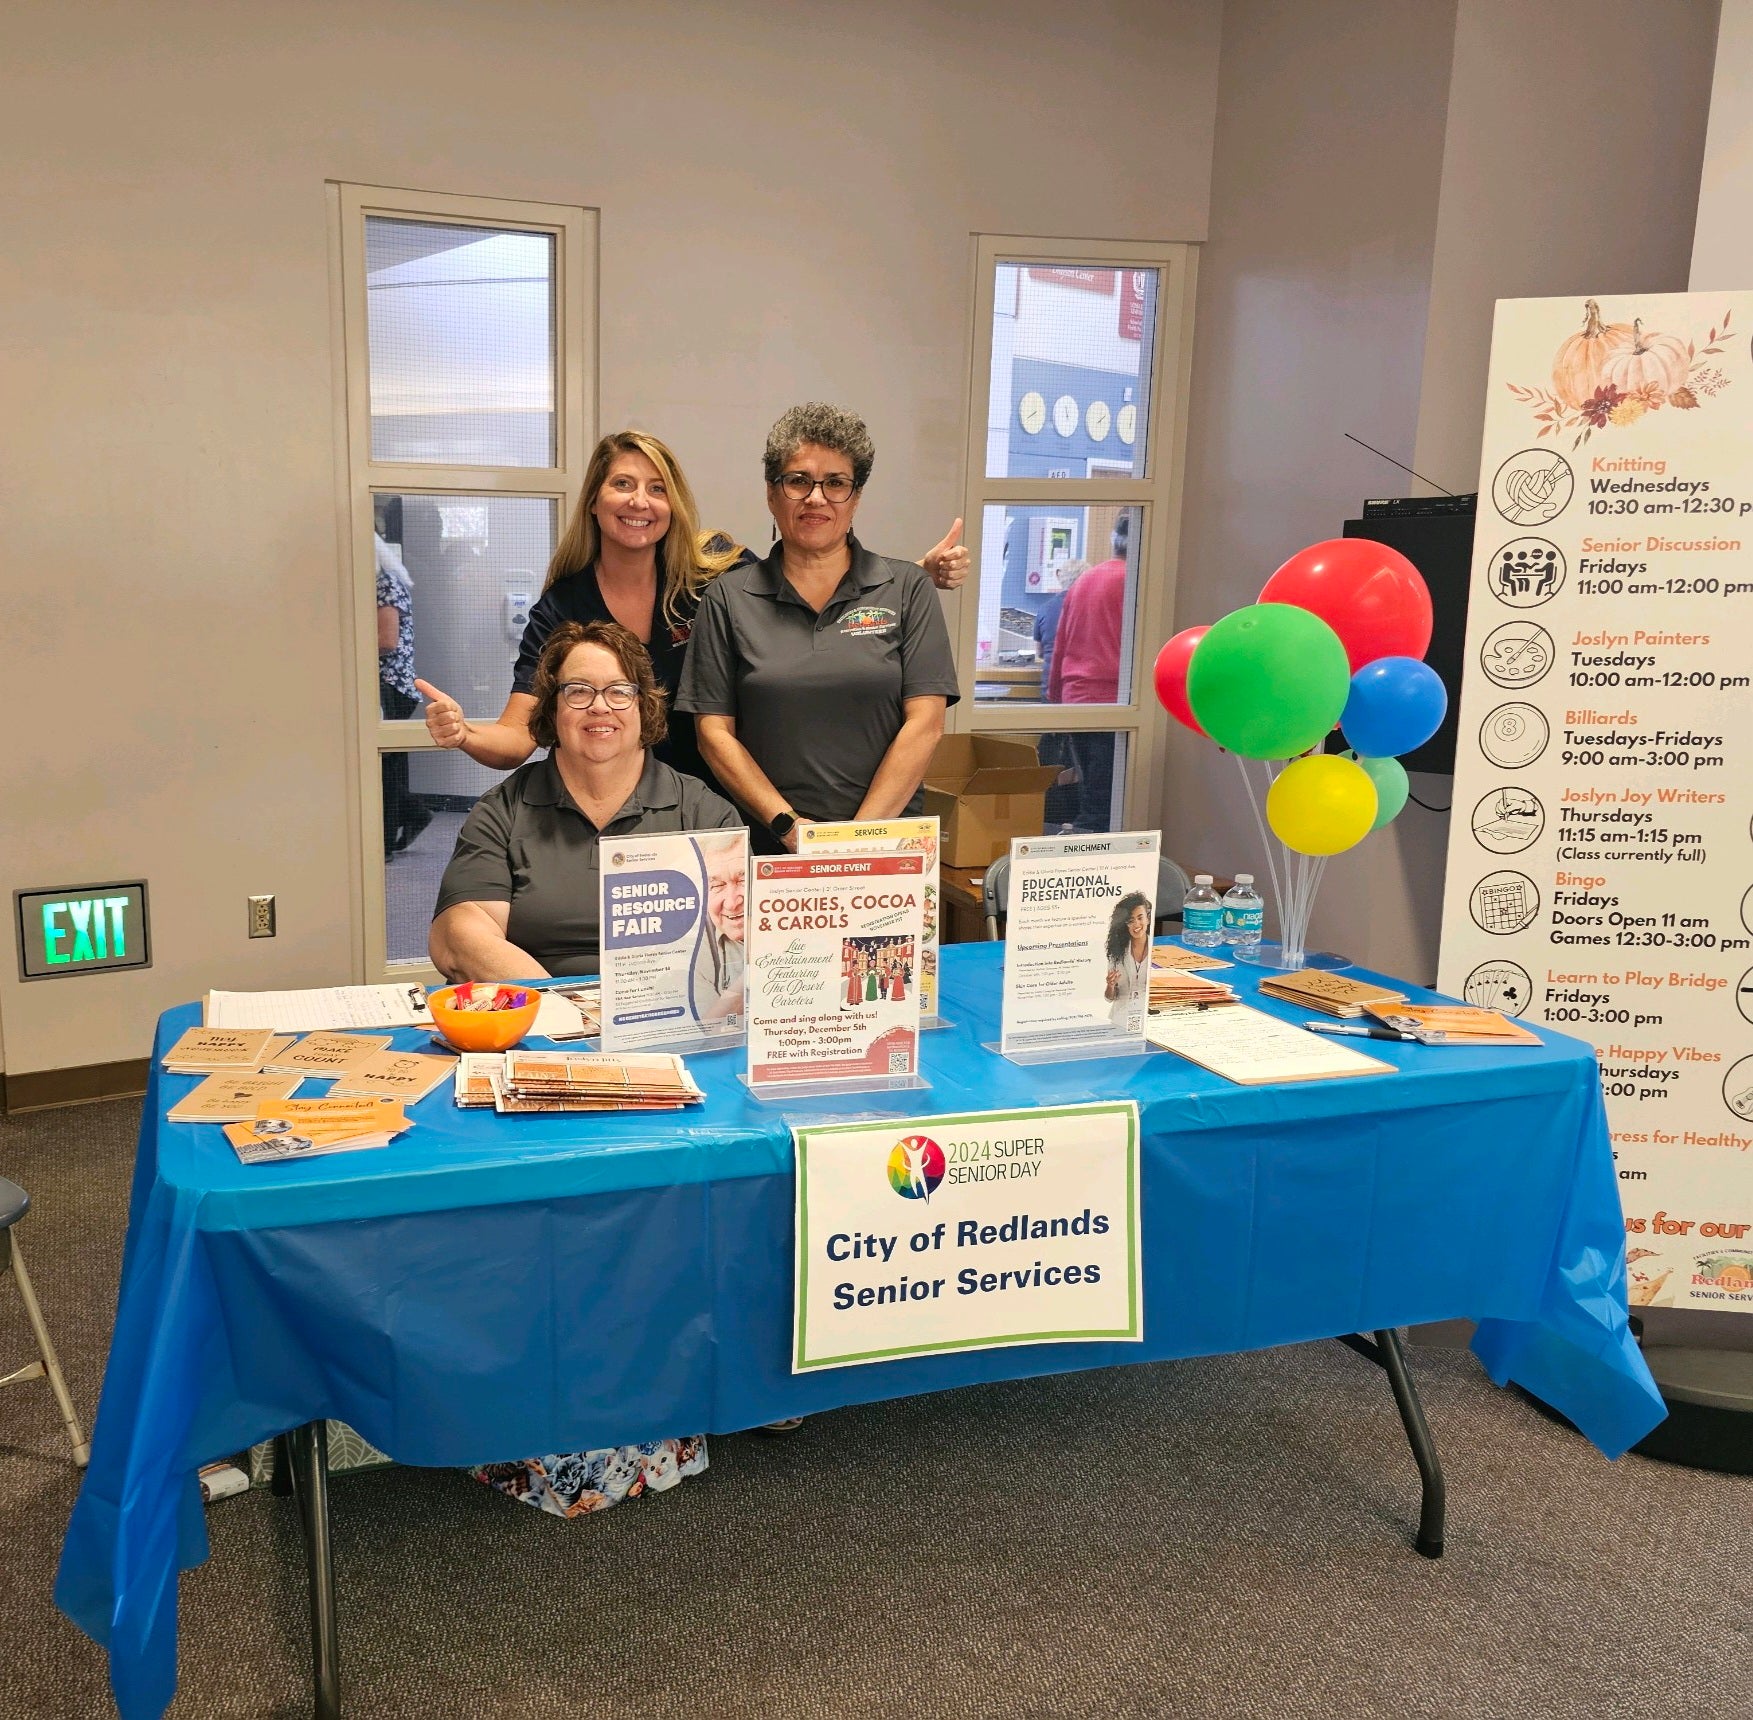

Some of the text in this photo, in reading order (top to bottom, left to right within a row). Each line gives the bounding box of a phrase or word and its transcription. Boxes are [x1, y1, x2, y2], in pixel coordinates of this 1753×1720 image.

[1592, 457, 1666, 475] Knitting
[1590, 477, 1710, 496] Wednesdays
[1588, 497, 1753, 517] 10:30 am-12:30 p
[1582, 536, 1741, 553] Senior Discussion
[1579, 558, 1647, 577] Fridays
[1578, 578, 1753, 597] 11:00 am-12:00 pm
[1572, 630, 1710, 649] Joslyn Painters
[1571, 651, 1656, 670] Tuesdays
[1569, 672, 1750, 690] 10:00 am-12:00 pm
[1565, 710, 1638, 725] Billiards
[1563, 731, 1723, 749] Tuesdays-Fridays
[1561, 751, 1724, 770] 9:00 am-3:00 pm
[1561, 788, 1726, 806] Joslyn Joy Writers
[1560, 807, 1653, 826] Thursdays
[854, 827, 887, 837] SERVICES
[1558, 828, 1702, 847] 11:15 am-1:15 pm
[1063, 843, 1111, 853] ENRICHMENT
[1556, 847, 1707, 865] (Class currently full)
[810, 864, 842, 874] SENIOR
[844, 863, 872, 873] EVENT
[1022, 875, 1110, 891] EDUCATIONAL
[1555, 871, 1606, 890] Bingo
[611, 882, 669, 899] SENIOR
[1021, 885, 1122, 902] PRESENTATIONS
[1489, 886, 1516, 895] BINGO
[612, 897, 696, 917] RESOURCE
[759, 893, 917, 913] COOKIES, COCOA
[1553, 892, 1619, 908] Fridays
[42, 895, 129, 964] EXIT
[612, 916, 662, 938] FAIR
[758, 913, 849, 932] & CAROLS
[1551, 911, 1709, 930] Doors Open 11 am
[1017, 940, 1089, 951] Upcoming Presentations
[1550, 931, 1751, 952] Games 12:30-3:00 pm
[755, 952, 834, 969] Entertainment
[767, 966, 820, 982] Featuring
[1547, 970, 1728, 991] Learn to Play Bridge
[762, 979, 825, 995] The Desert
[771, 994, 814, 1008] Carolers
[1545, 989, 1610, 1007] Fridays
[753, 1010, 878, 1026] Come and sing along with us!
[1543, 1008, 1663, 1027] 1:00-3:00 pm
[764, 1023, 867, 1037] Thursday, December 5th
[778, 1037, 811, 1047] 1:00pm
[818, 1036, 852, 1046] 3:00pm
[293, 1054, 349, 1064] COUNT
[767, 1047, 862, 1059] FREE with Registration
[1609, 1045, 1668, 1063] Happy
[1672, 1046, 1721, 1062] Vibes
[364, 1073, 417, 1082] HAPPY
[1599, 1063, 1679, 1082] hursdays
[1600, 1083, 1668, 1101] :00 pm
[285, 1103, 312, 1112] Stay
[1653, 1129, 1679, 1144] for
[1684, 1131, 1752, 1151] Healthy
[948, 1138, 1044, 1164] 2024 SUPER
[948, 1161, 1042, 1185] SENIOR DAY
[1619, 1170, 1647, 1180] am
[1626, 1211, 1750, 1239] us for our
[826, 1209, 1110, 1262] City of Redlands
[833, 1261, 1101, 1310] Senior Services
[1691, 1274, 1753, 1288] Redlan
[1690, 1291, 1753, 1302] SENIOR SERV
